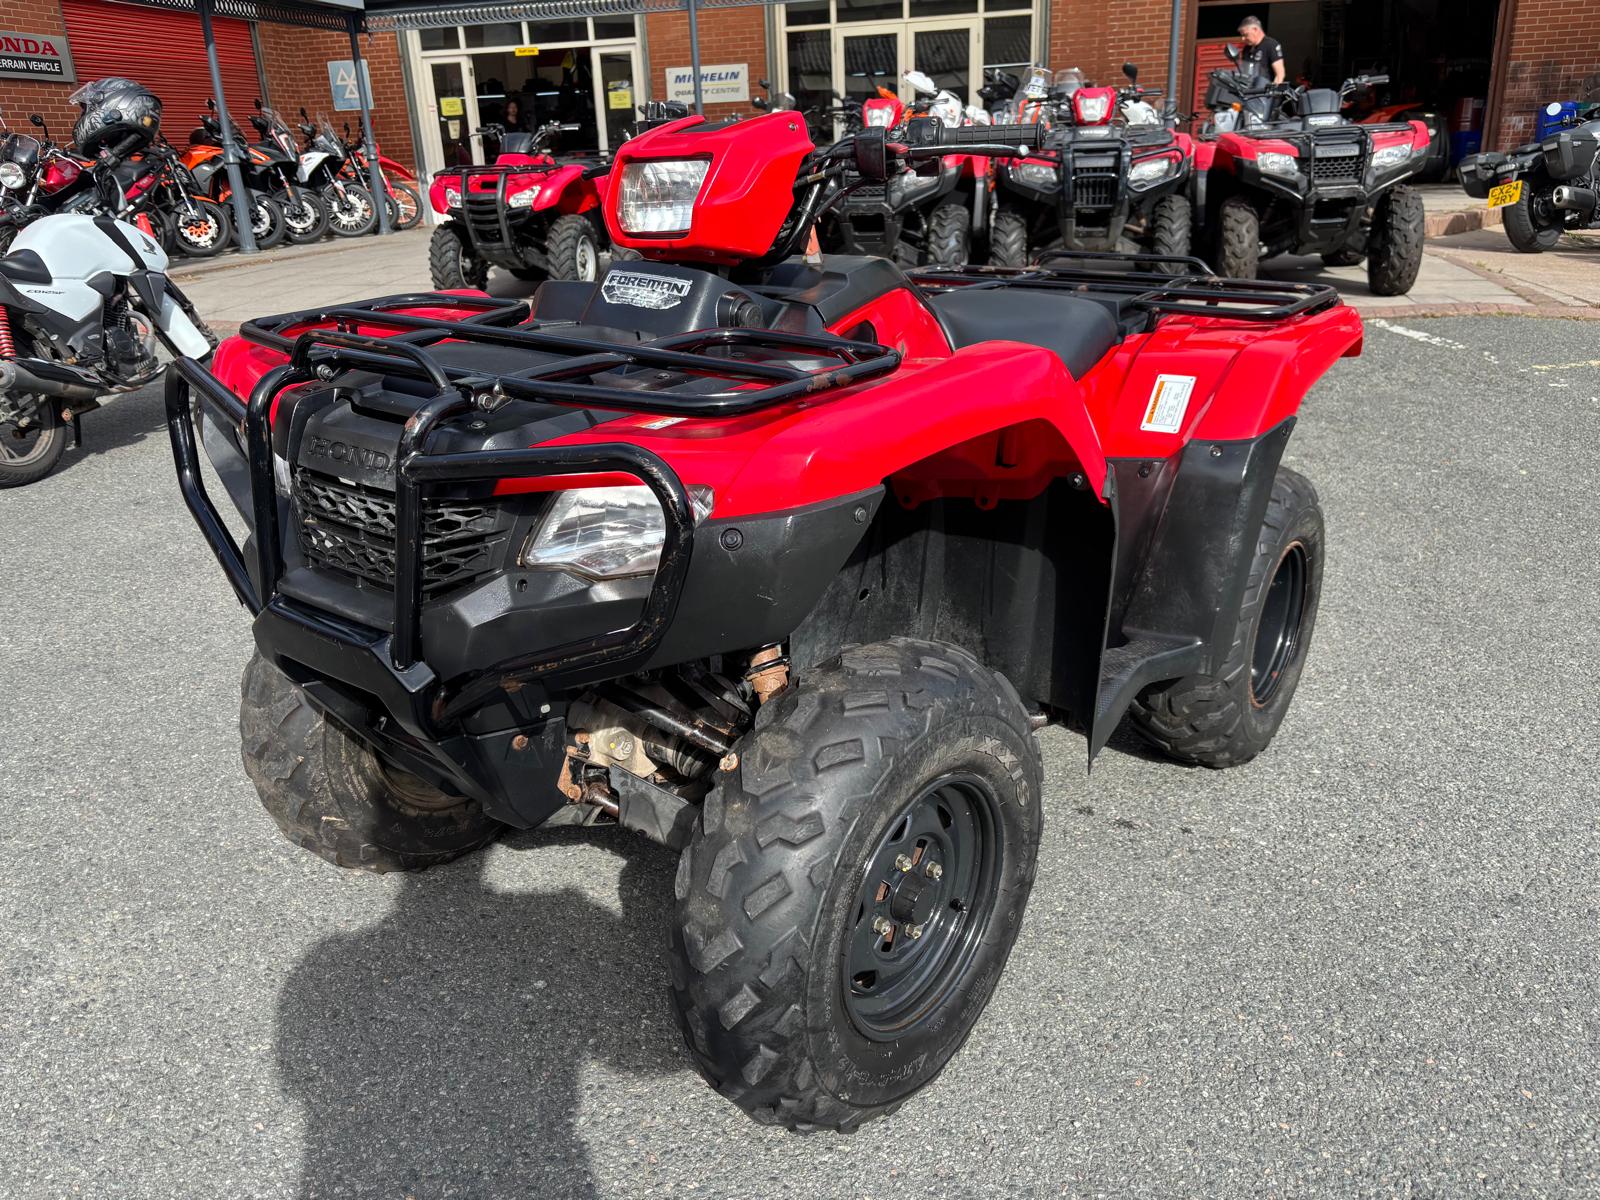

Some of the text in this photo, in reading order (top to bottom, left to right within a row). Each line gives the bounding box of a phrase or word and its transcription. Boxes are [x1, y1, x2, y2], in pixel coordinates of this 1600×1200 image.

[0, 36, 60, 56] NDA
[27, 61, 61, 72] VEHICLE
[711, 87, 741, 95] CENTRE
[1491, 182, 1519, 198] CX24
[1493, 192, 1514, 206] ZRY
[608, 274, 686, 294] FOREMAN
